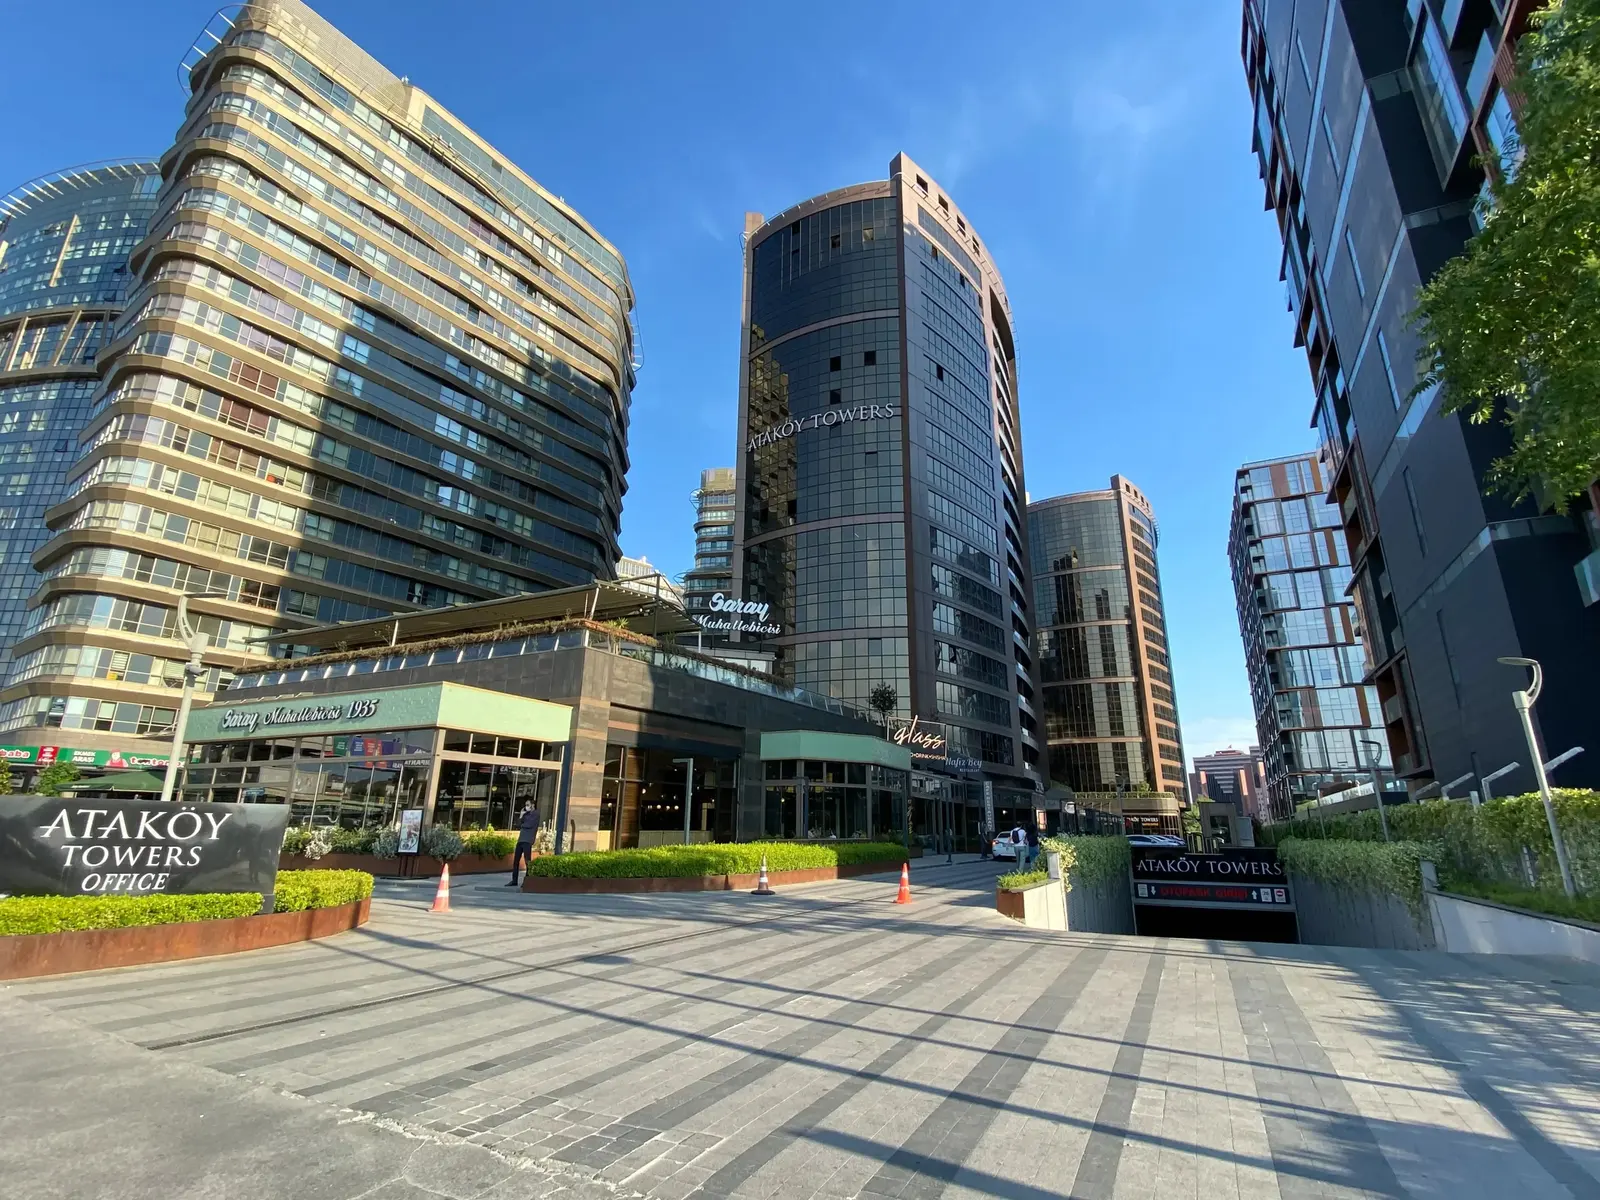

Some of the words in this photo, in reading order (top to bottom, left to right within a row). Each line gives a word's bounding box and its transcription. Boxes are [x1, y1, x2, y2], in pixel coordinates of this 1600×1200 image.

[747, 417, 805, 452] ATAKÖY
[811, 403, 894, 429] TOWERS
[709, 592, 769, 622] Saray
[692, 614, 781, 635] Muhallebicisi
[222, 709, 258, 732] Saray
[263, 705, 342, 725] Muhallebicisi
[346, 699, 379, 719] 1935
[893, 714, 945, 750] glass
[40, 807, 232, 840] ATAKÖY
[61, 845, 202, 867] TOWERS
[1136, 857, 1200, 873] ATAKÖY
[1206, 861, 1282, 875] TOWERS
[82, 872, 169, 892] OFFICE
